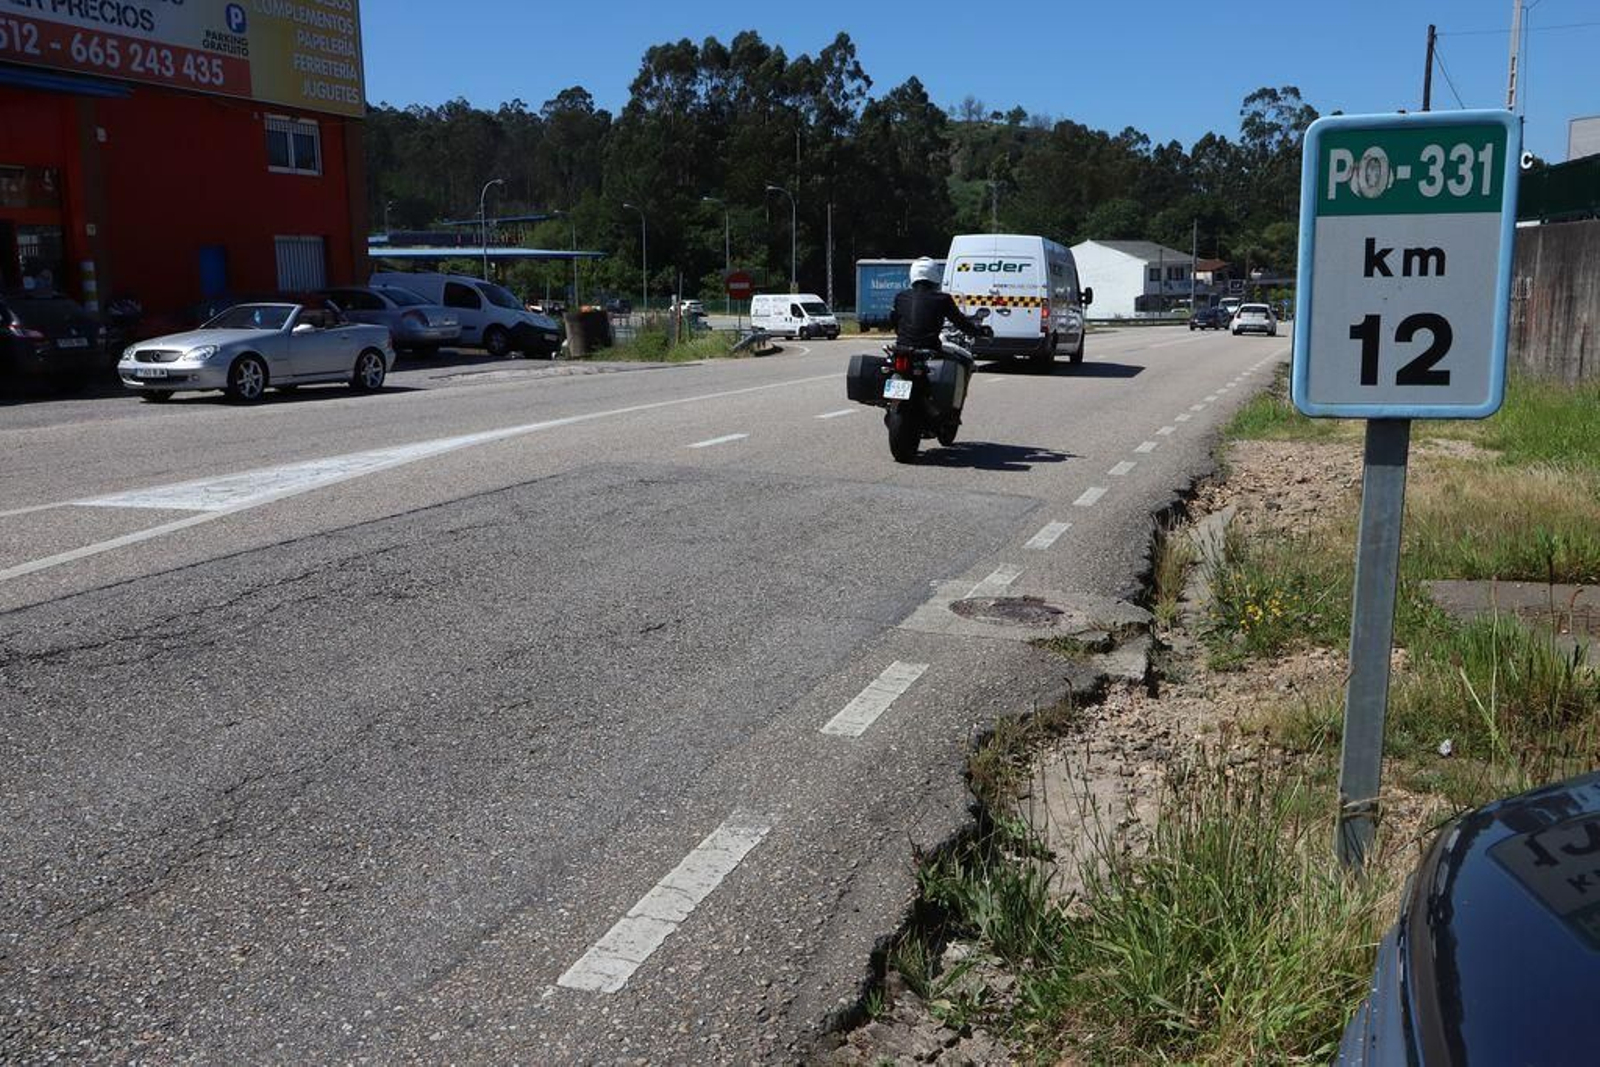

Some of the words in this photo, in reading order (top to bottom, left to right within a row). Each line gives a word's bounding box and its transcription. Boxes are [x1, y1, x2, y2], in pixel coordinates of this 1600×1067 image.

[252, 0, 354, 35] COMPLEMENTOS
[203, 39, 249, 57] GRATUITO
[205, 30, 248, 47] PARKING
[297, 29, 355, 58] PAPELERÍA
[71, 32, 120, 69] 665
[128, 42, 175, 77] 243
[182, 52, 224, 86] 435
[293, 53, 358, 80] FERRETERÍA
[302, 79, 360, 103] JUGUETES
[1327, 142, 1494, 200] PO-331
[972, 260, 1032, 273] ader
[1363, 237, 1447, 278] km
[1349, 312, 1454, 386] 12
